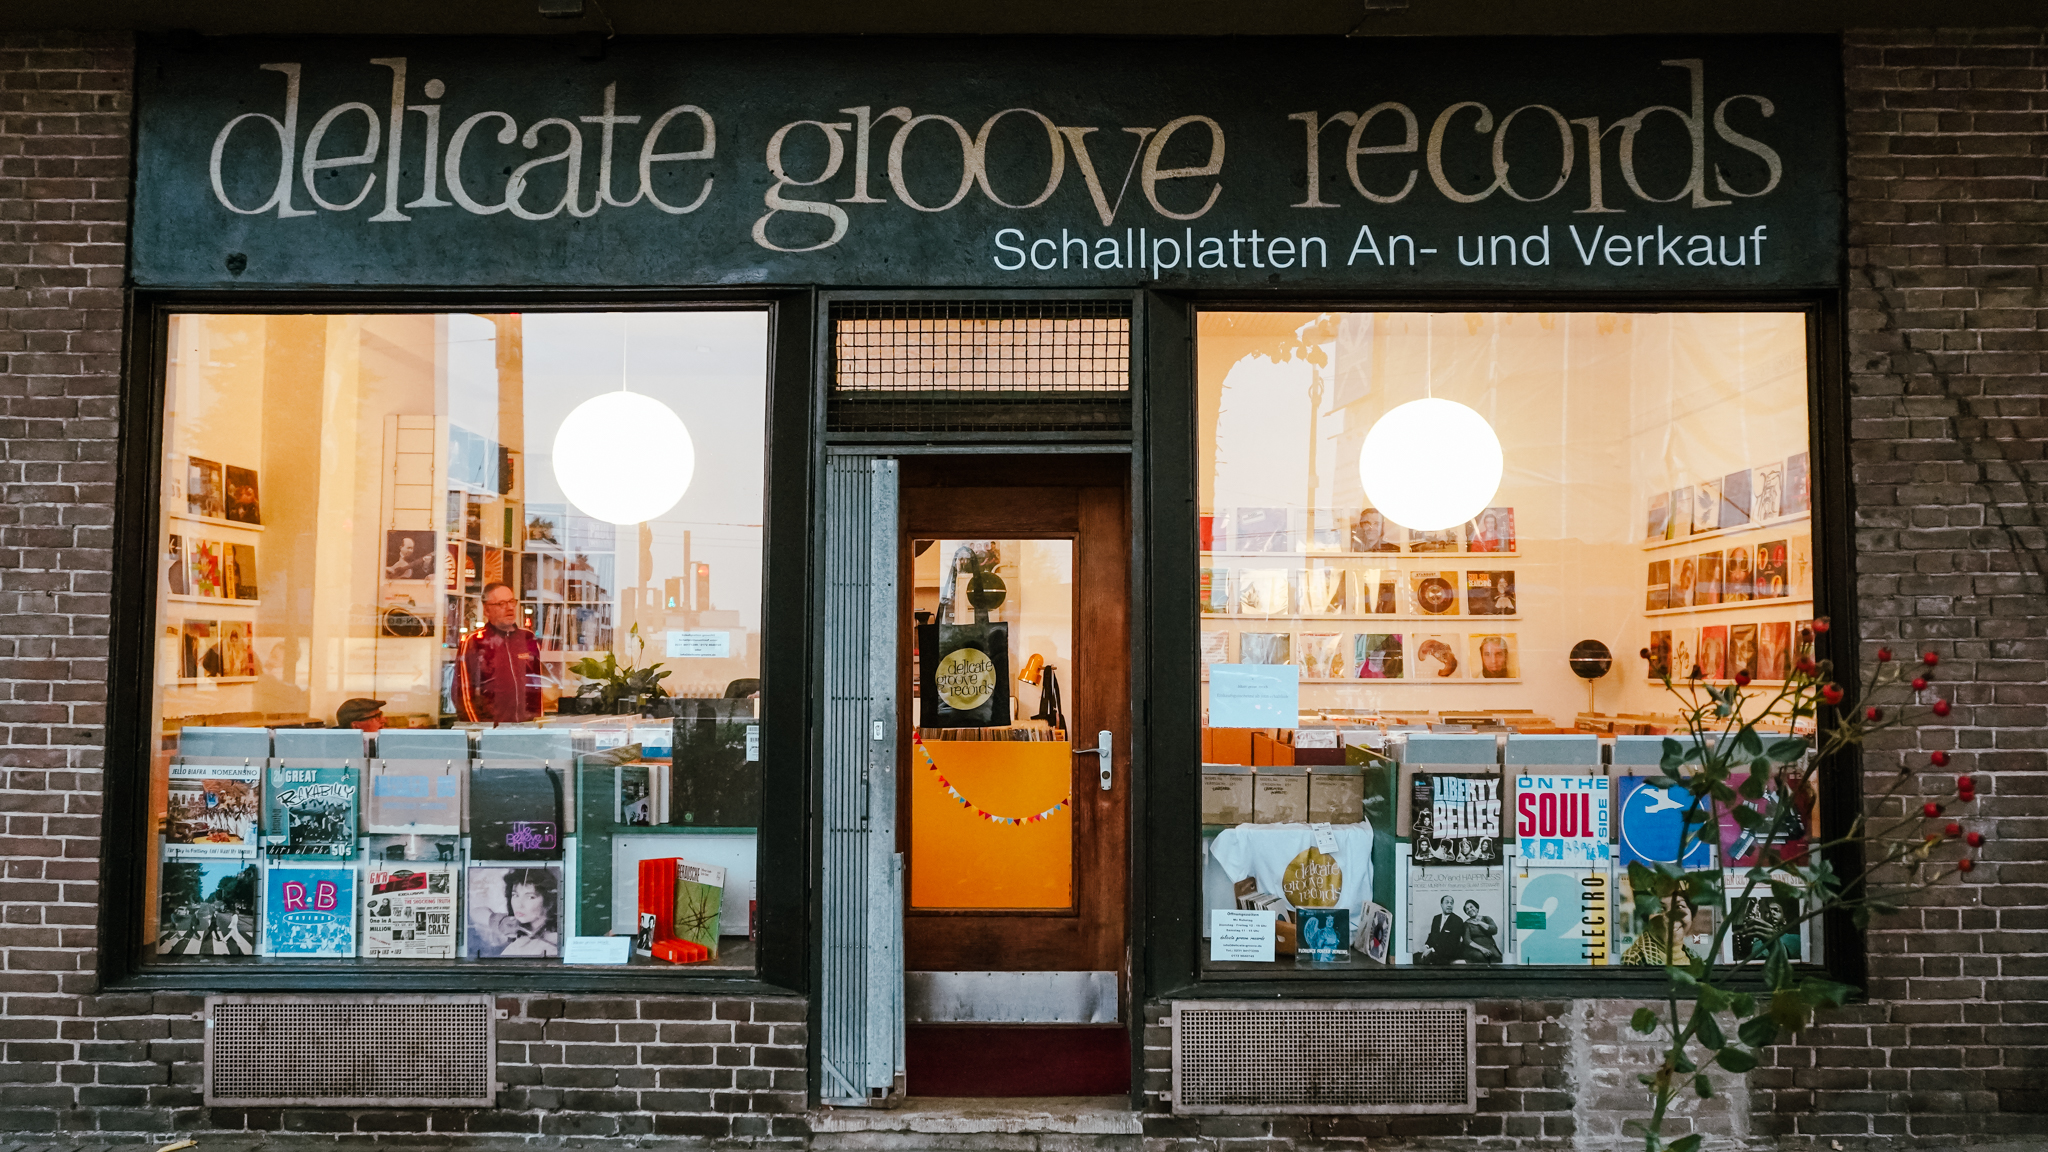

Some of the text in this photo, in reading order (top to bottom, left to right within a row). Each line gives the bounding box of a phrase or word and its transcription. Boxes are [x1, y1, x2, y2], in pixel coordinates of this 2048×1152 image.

[209, 57, 1783, 252] delicate groove records
[993, 224, 1768, 280] Schallplatten An- und Verkauf
[948, 659, 993, 675] delicate
[936, 674, 978, 690] groove
[950, 680, 994, 696] records
[285, 770, 317, 782] GREAT
[1518, 778, 1608, 790] ON THE
[1432, 776, 1500, 802] LIBERTY
[1432, 799, 1501, 839] BELLES
[1518, 792, 1594, 838] SOUL
[1598, 798, 1608, 838] SIDE
[1295, 860, 1340, 880] delicate
[371, 876, 424, 896] LIES
[1284, 876, 1323, 895] groove
[1300, 884, 1341, 902] records
[428, 914, 450, 924] YOU'RE
[1520, 873, 1588, 964] 2
[1582, 877, 1605, 960] ELECTRO
[428, 924, 449, 935] CRAZY
